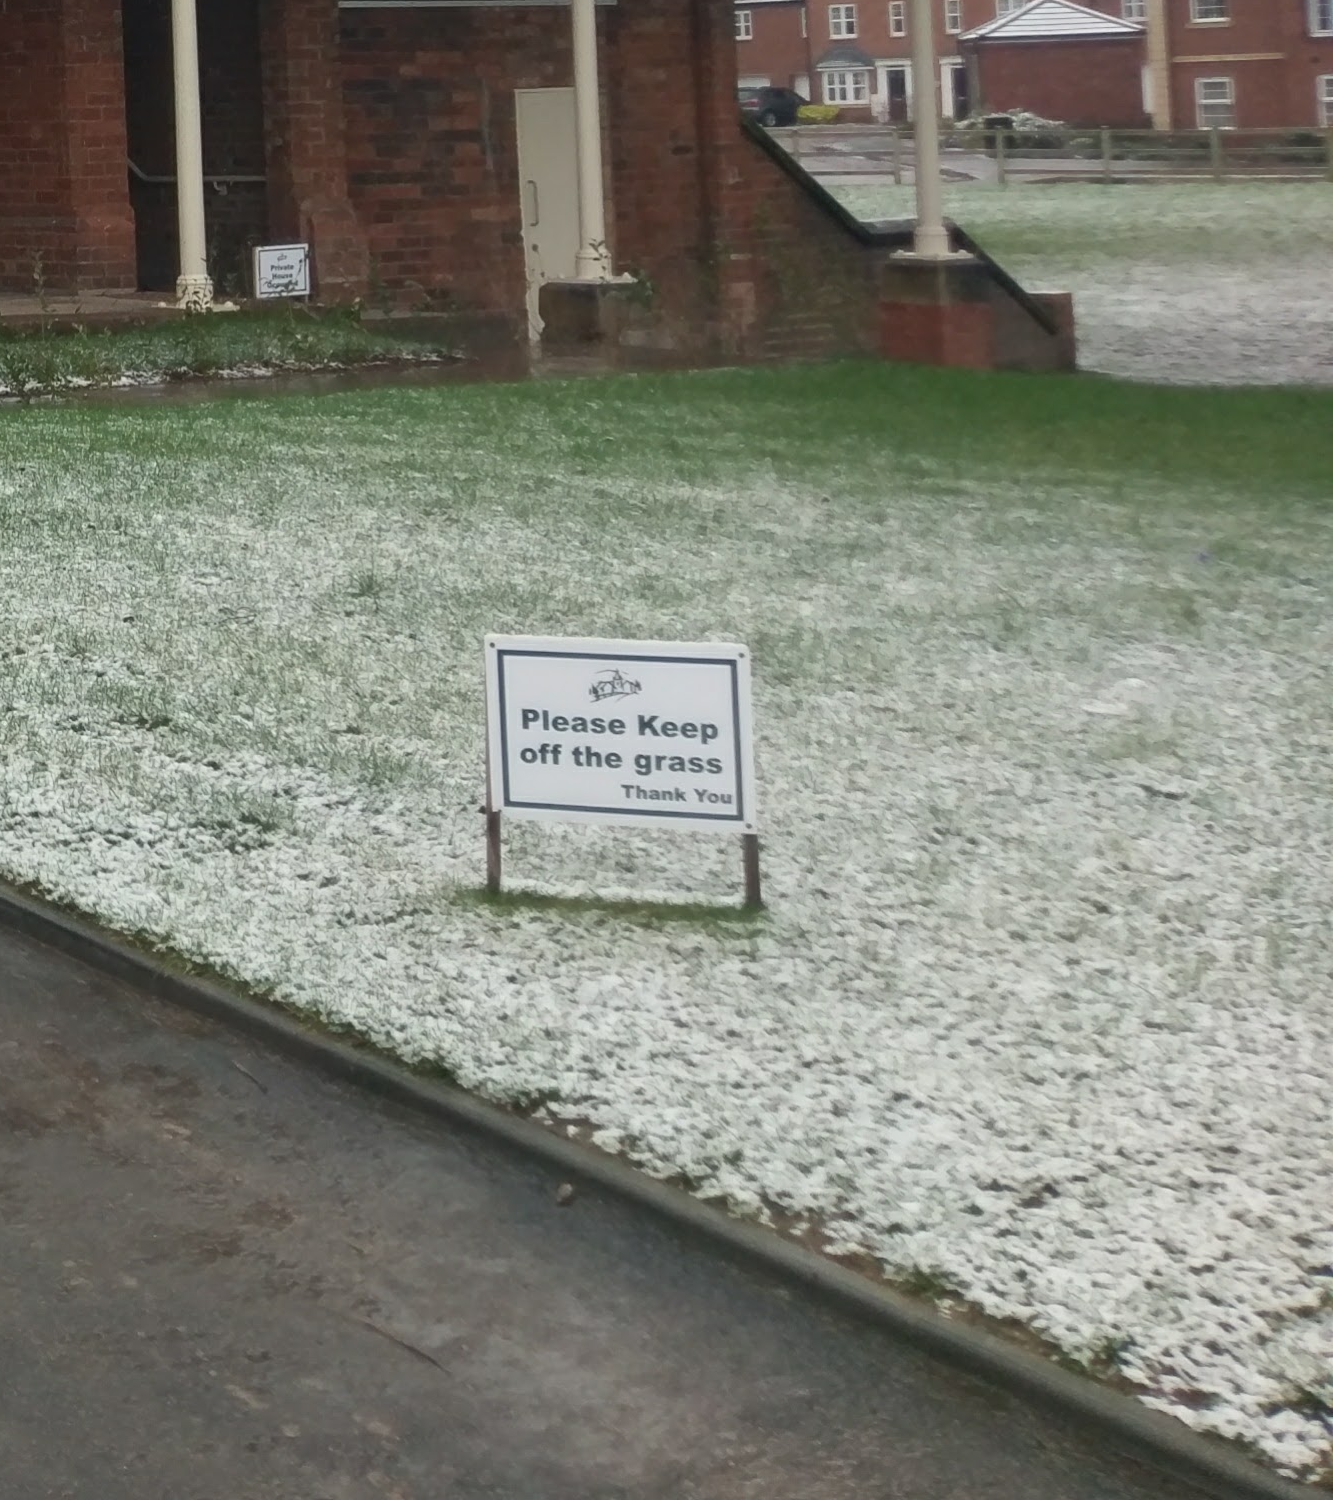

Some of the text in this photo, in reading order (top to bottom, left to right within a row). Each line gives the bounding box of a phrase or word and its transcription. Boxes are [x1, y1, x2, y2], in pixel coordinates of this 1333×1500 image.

[521, 708, 719, 745] Please Keep
[519, 744, 723, 776] off the grass
[621, 783, 733, 805] Thank You
